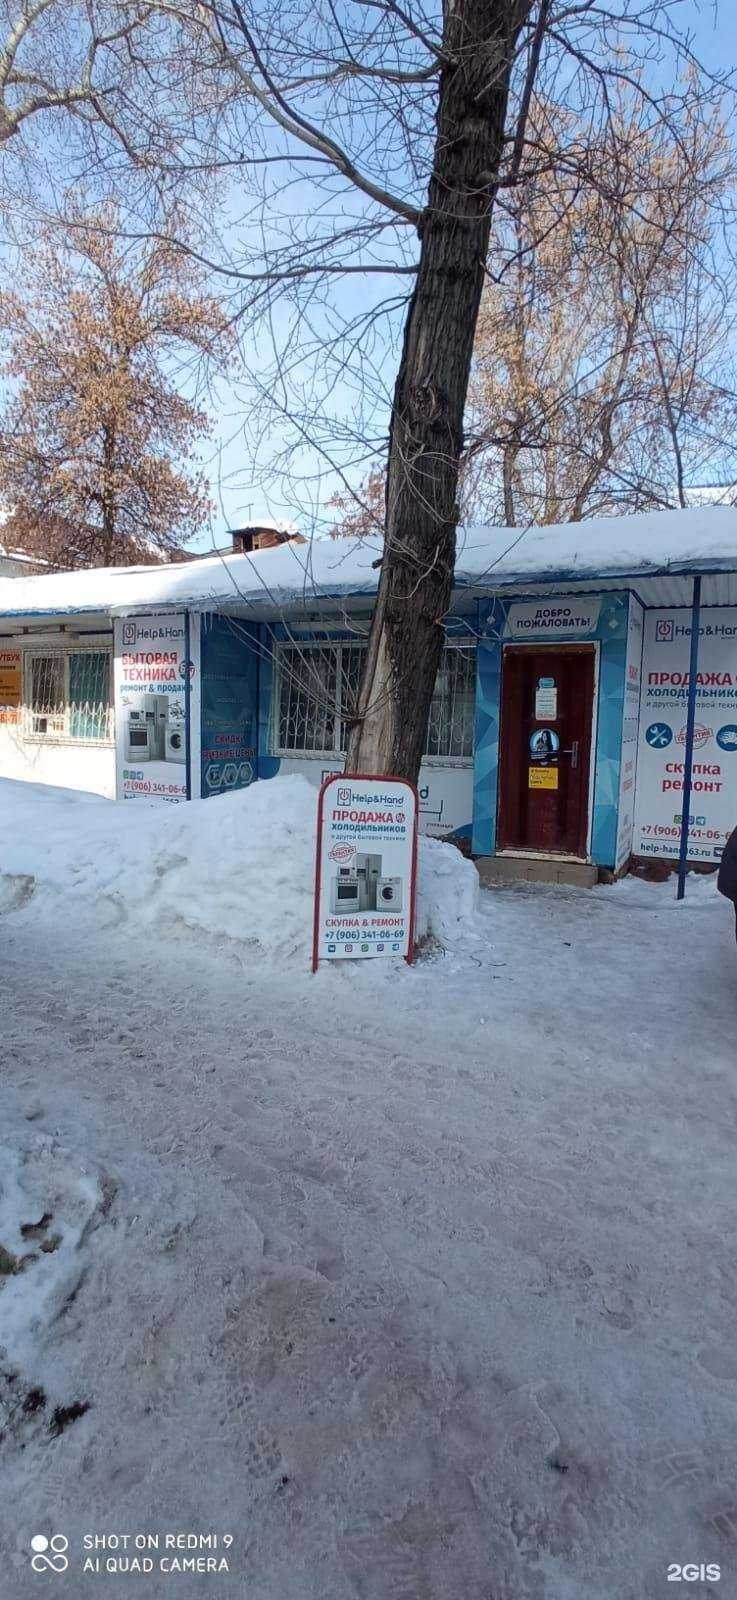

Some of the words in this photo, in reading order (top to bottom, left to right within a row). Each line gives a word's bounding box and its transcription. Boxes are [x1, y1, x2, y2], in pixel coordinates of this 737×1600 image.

[535, 608, 571, 618] ДОБРО
[516, 618, 591, 629] ПОЖАЛОВАТЬ!
[137, 627, 187, 640] Help&Han
[122, 651, 178, 665] БЫТОВАЯ
[123, 668, 177, 681] ТЕХНИКА
[120, 684, 147, 692] ремонт
[149, 683, 155, 692] &
[131, 780, 151, 791] (906)
[153, 783, 188, 794] 341-06-6
[662, 780, 723, 792] реонт
[352, 793, 404, 804] Help&Hand
[332, 810, 394, 824] ПРОДАЖА
[331, 823, 406, 833] холодильников
[641, 825, 652, 834] +7
[653, 825, 682, 837] (906)
[325, 918, 360, 927] СКУПКА
[371, 918, 404, 927] РЕМОНТ
[325, 931, 335, 939] +7
[336, 929, 360, 940] (906)
[361, 929, 404, 939] 341-06-69
